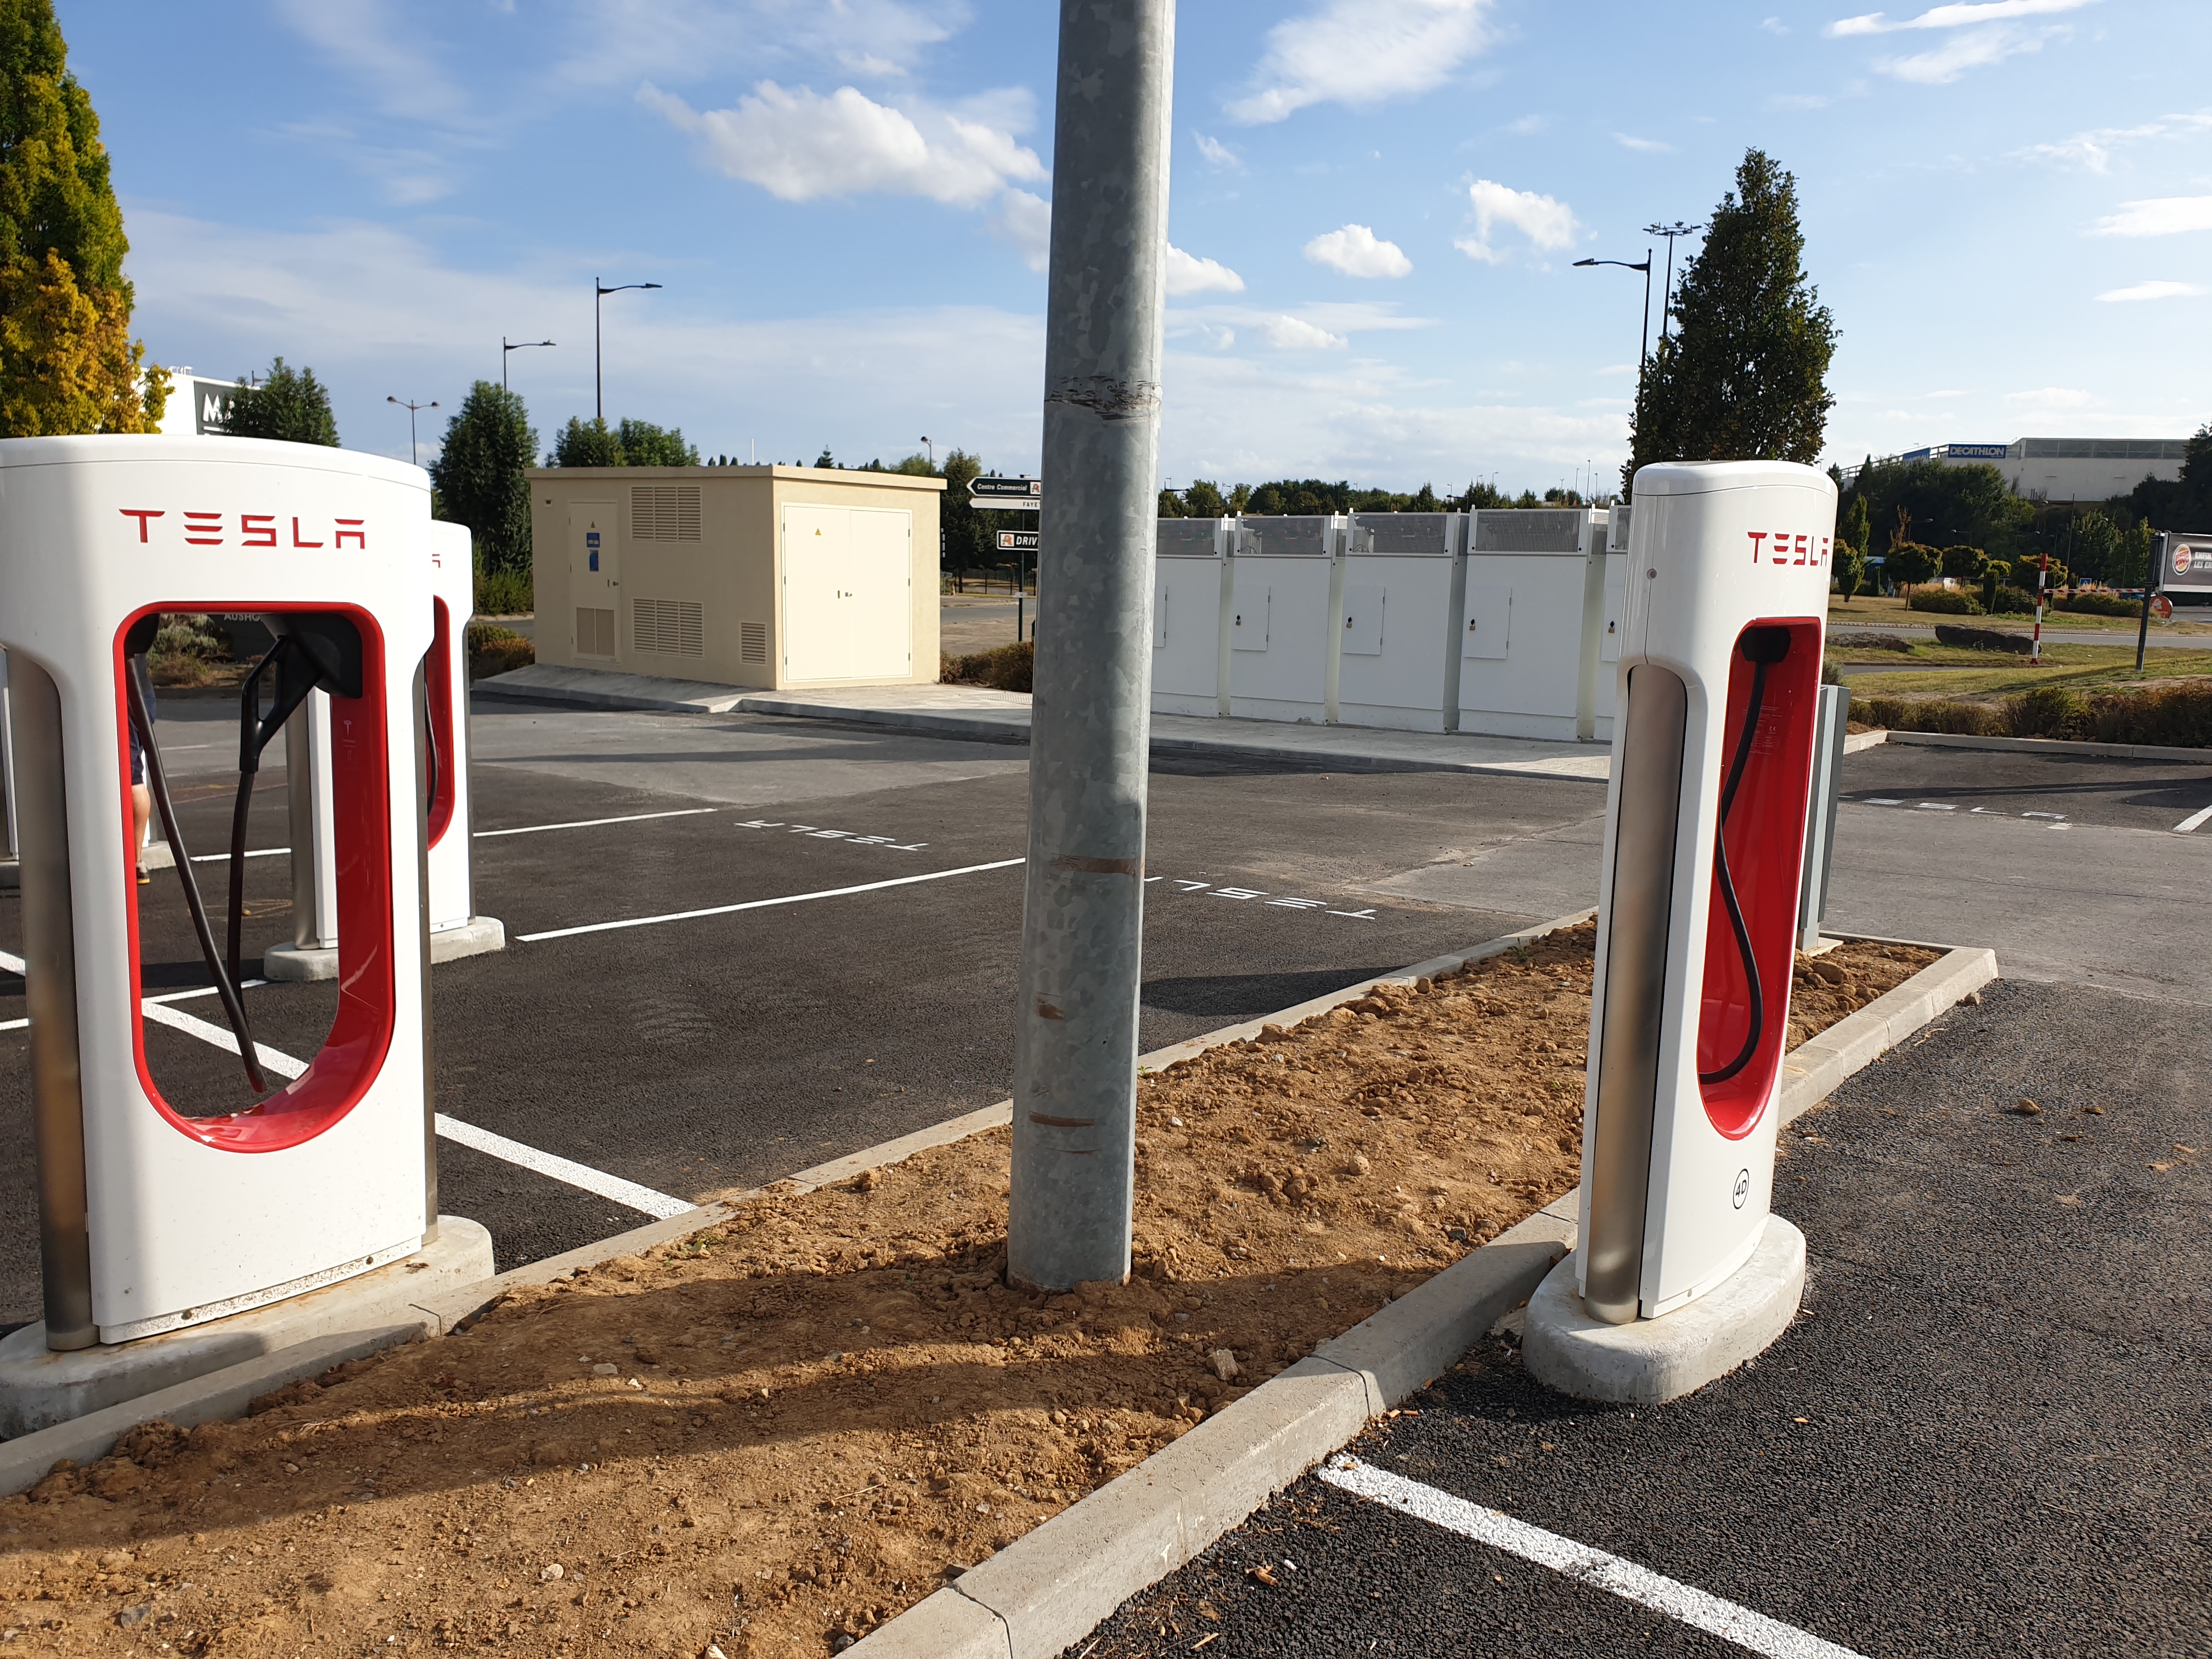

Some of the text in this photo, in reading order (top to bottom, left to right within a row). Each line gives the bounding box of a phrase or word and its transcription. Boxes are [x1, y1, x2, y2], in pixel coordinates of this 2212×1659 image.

[1950, 447, 2004, 456] DECATHLON
[119, 509, 365, 550] TESLA
[1016, 536, 1039, 546] DRIV
[1747, 532, 1829, 567] TESLA
[1838, 795, 2068, 819] ESLA
[1735, 1179, 1747, 1197] 4D
